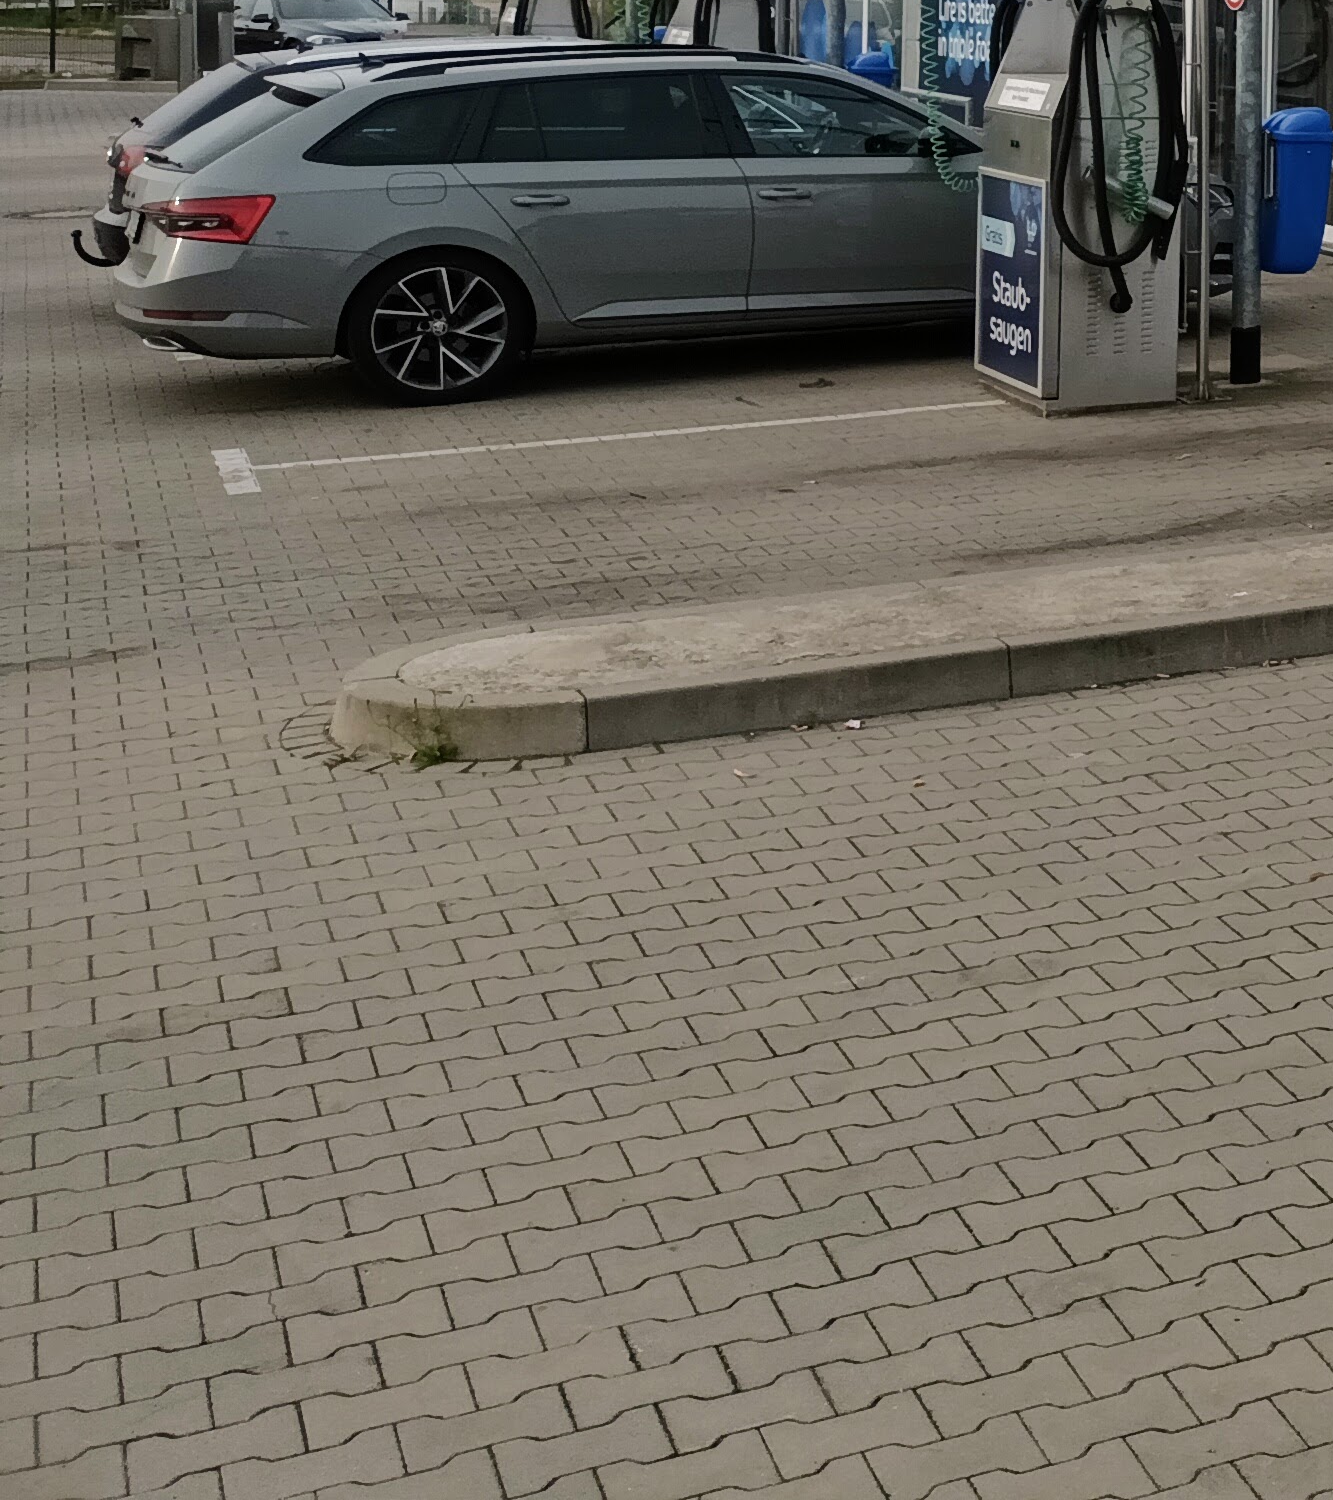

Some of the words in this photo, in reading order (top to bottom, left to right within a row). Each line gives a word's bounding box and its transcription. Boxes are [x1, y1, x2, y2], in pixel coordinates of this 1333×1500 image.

[937, 28, 947, 57] in
[992, 270, 1031, 311] Staub-
[989, 316, 1032, 356] saugen
